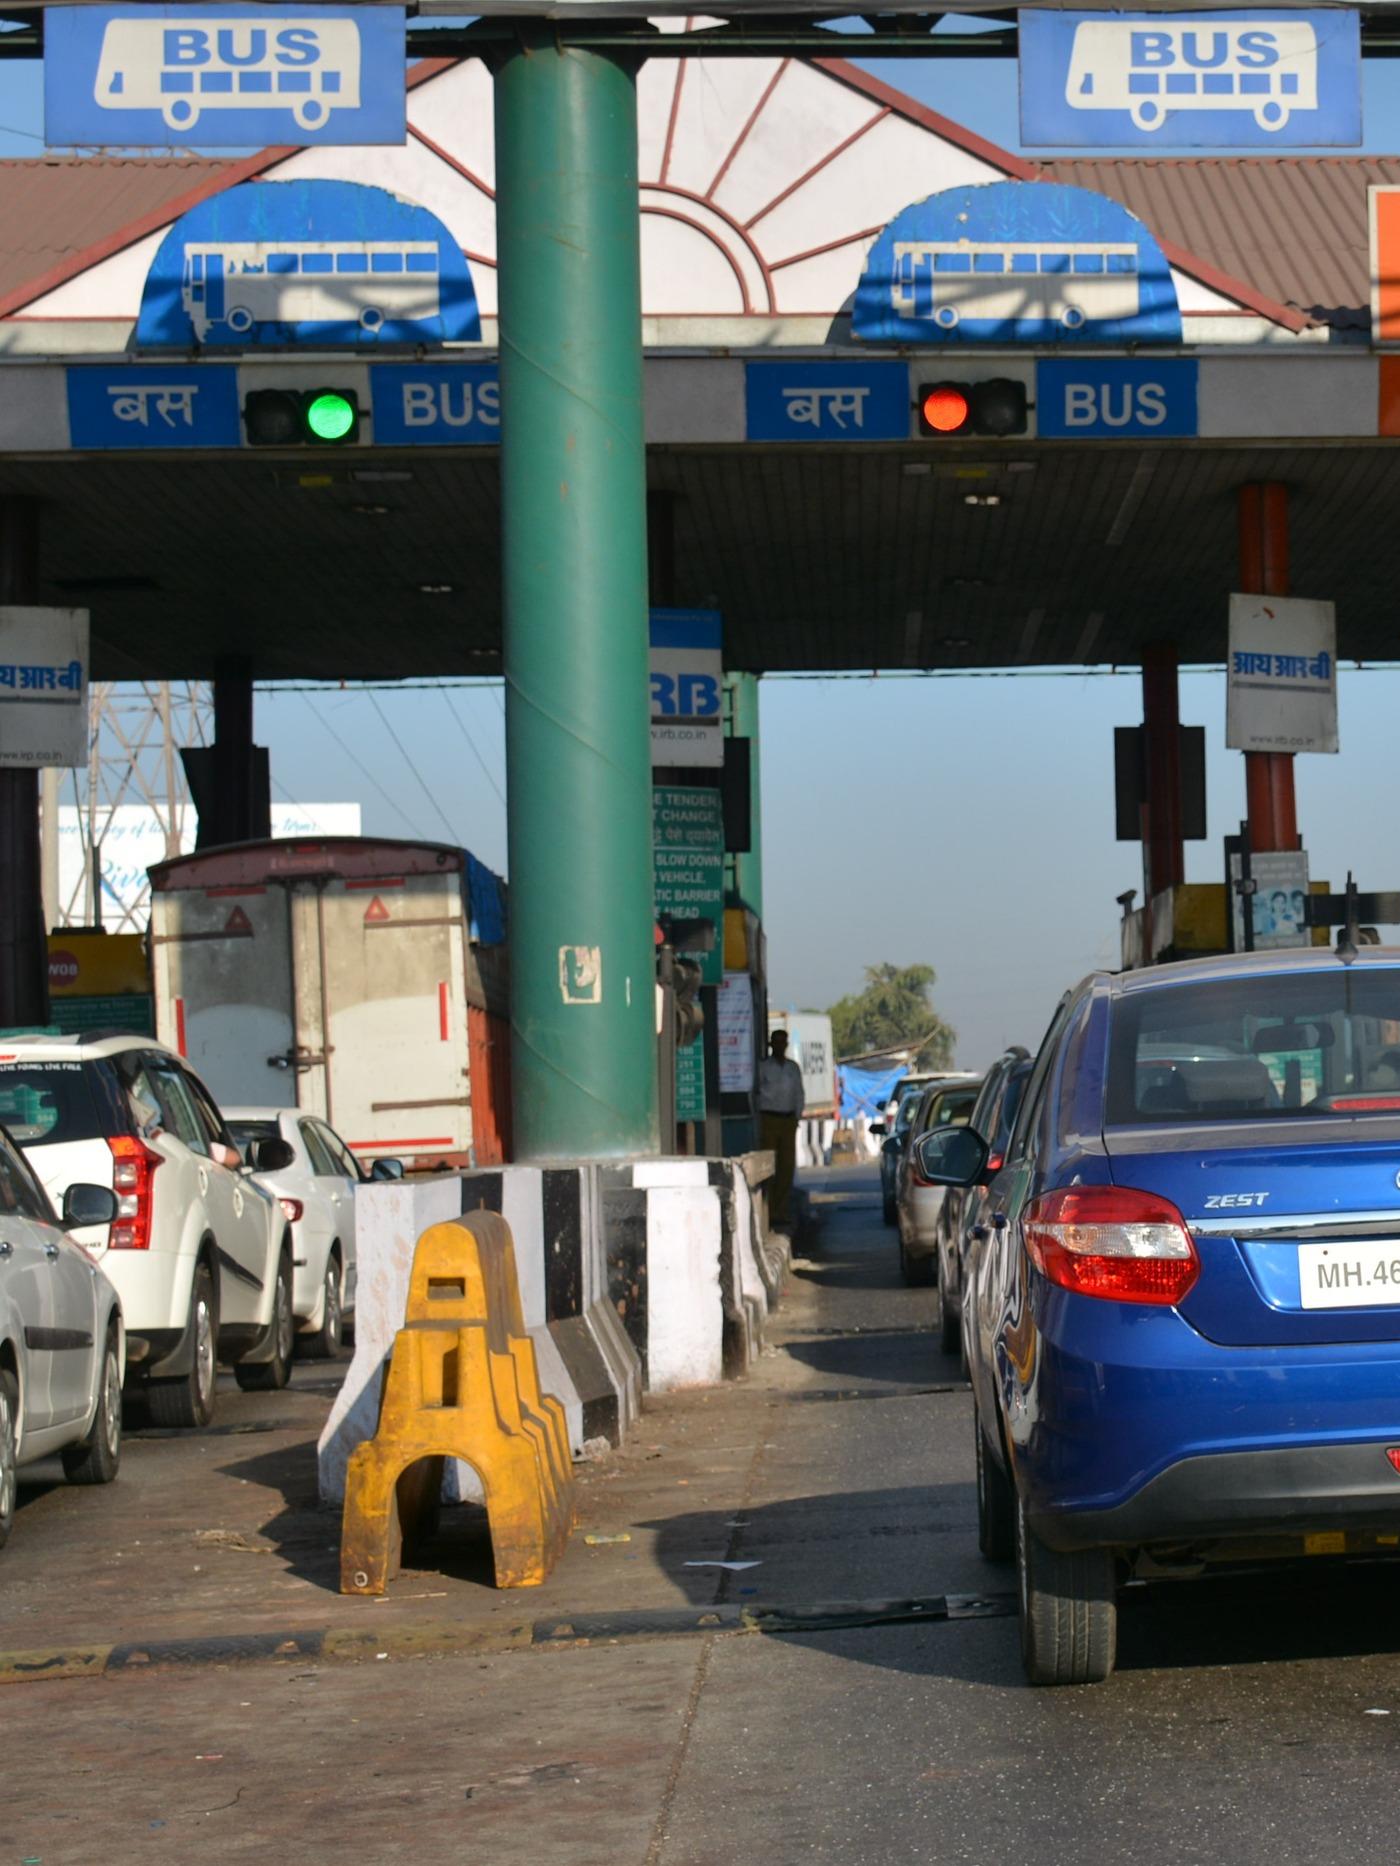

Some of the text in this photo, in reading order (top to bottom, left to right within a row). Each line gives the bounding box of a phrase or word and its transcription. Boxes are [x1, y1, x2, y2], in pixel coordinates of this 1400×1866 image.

[163, 28, 321, 67] BUS
[1129, 30, 1280, 69] BUS
[107, 384, 198, 428] बस
[402, 382, 500, 428] BUS
[782, 387, 870, 429] बस
[1064, 382, 1167, 428] BUS
[650, 671, 721, 717] RB
[661, 809, 716, 823] CHANGE
[666, 793, 718, 808] TENDER
[655, 853, 722, 868] SLOW DOWN
[674, 888, 721, 902] BARRIER
[1203, 1192, 1270, 1209] ZEST
